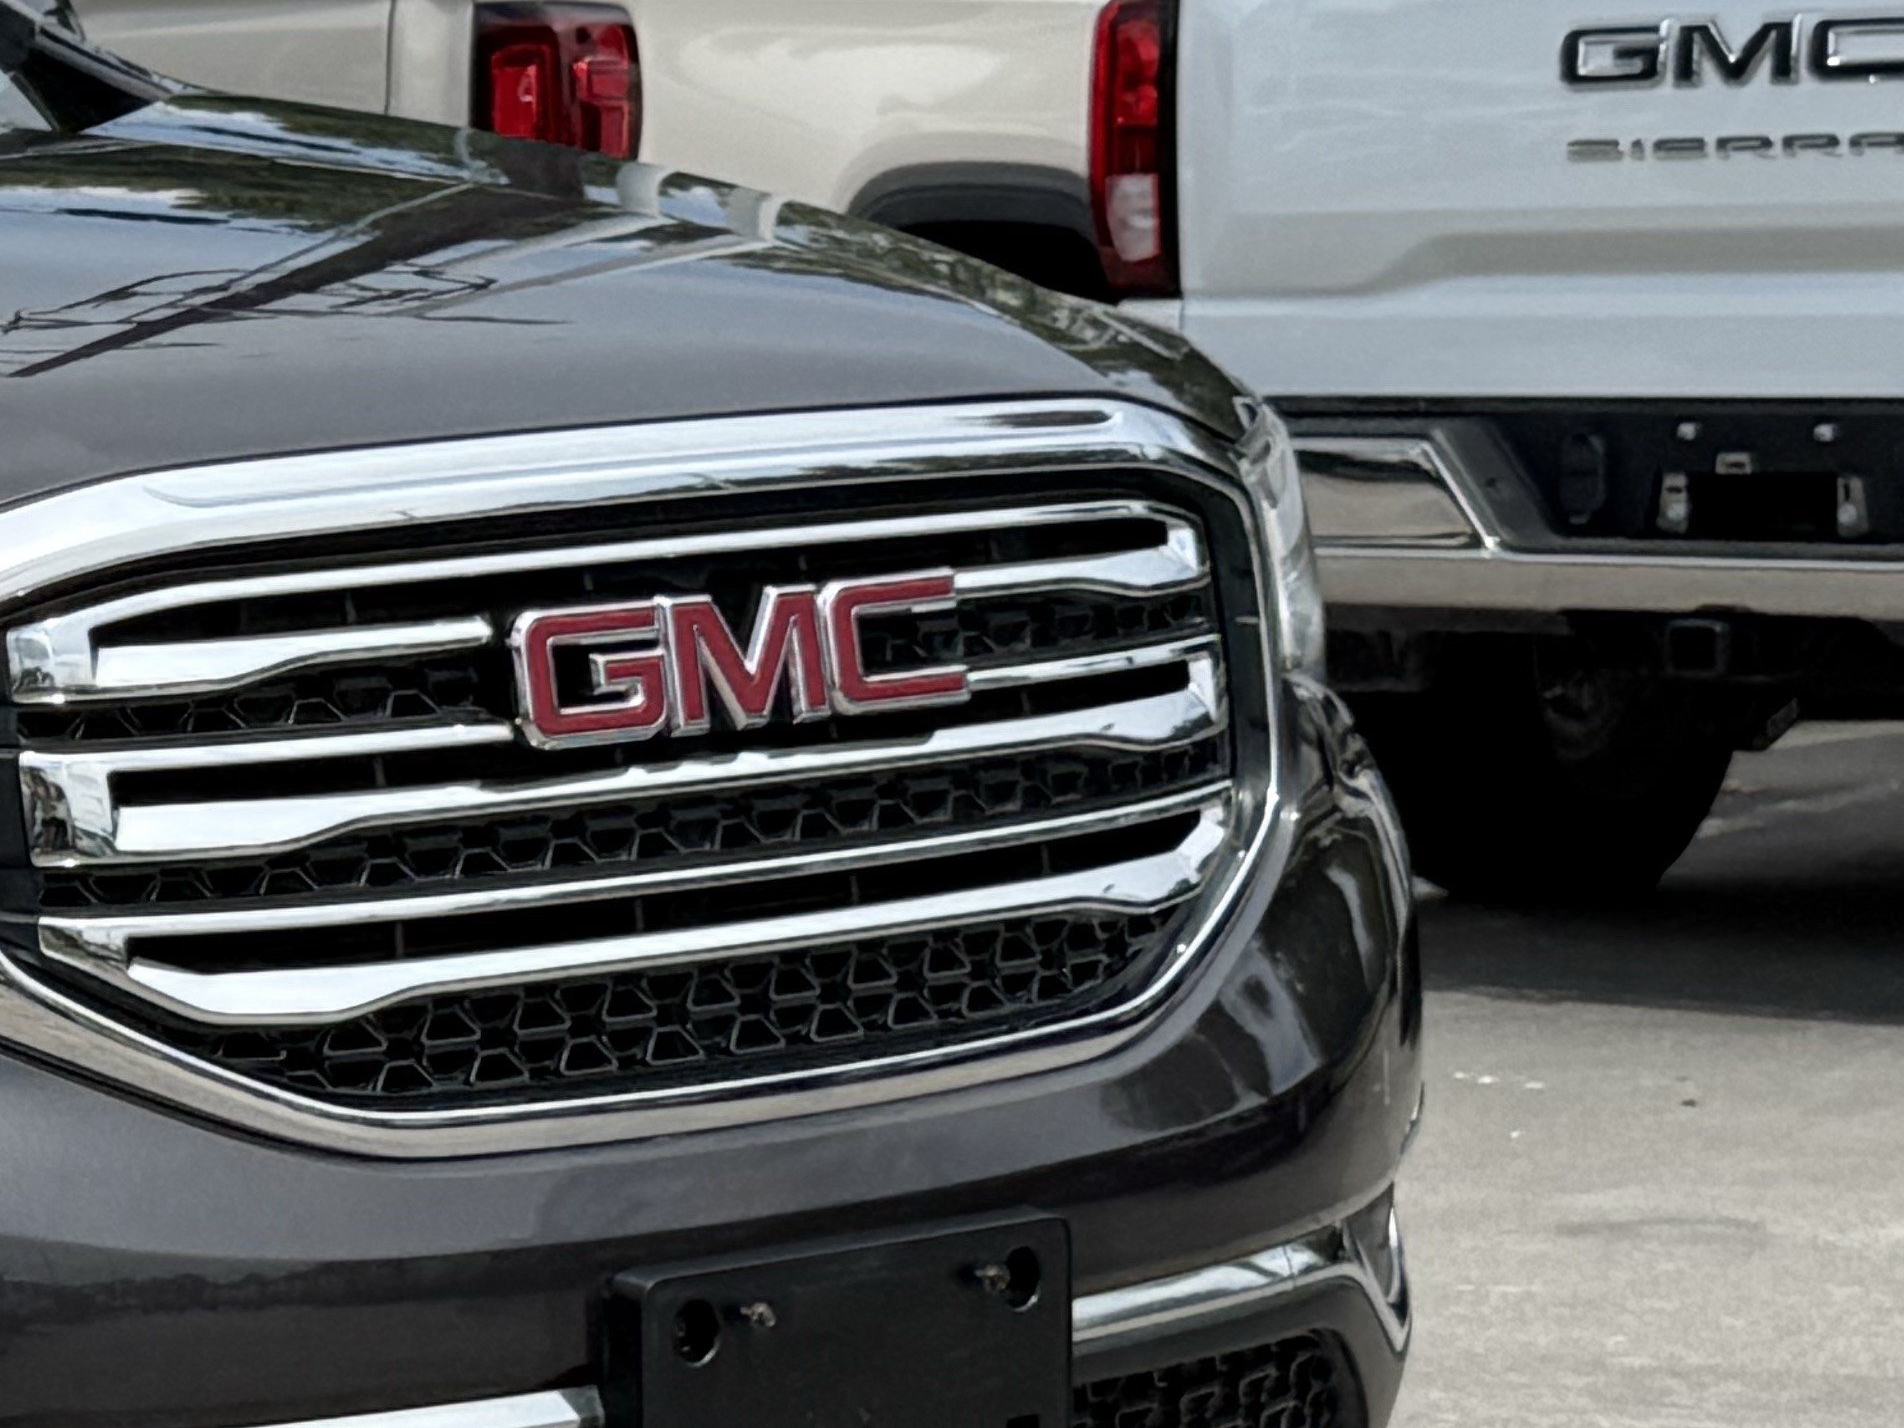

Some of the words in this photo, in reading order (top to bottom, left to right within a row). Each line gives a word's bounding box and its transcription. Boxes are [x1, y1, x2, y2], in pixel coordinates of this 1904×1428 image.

[1559, 13, 1904, 88] GMC
[1567, 132, 1904, 161] SIERRA
[510, 567, 970, 750] GMC
